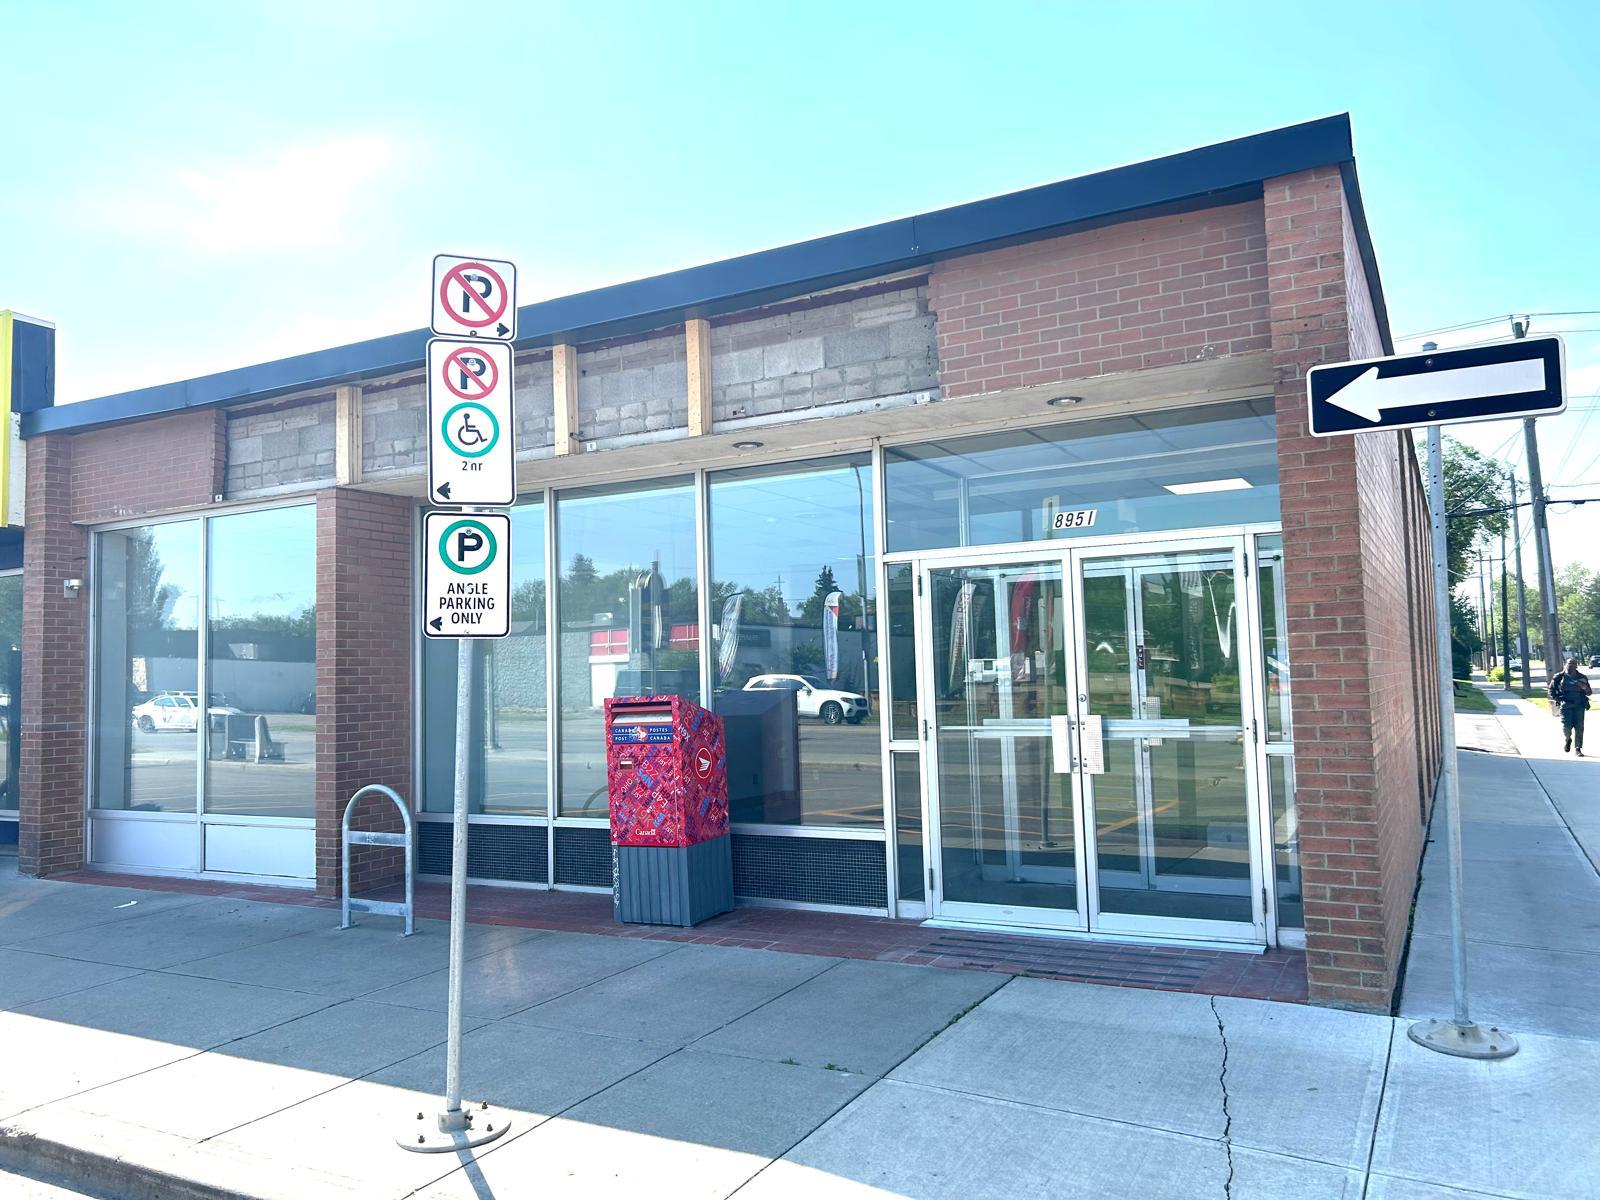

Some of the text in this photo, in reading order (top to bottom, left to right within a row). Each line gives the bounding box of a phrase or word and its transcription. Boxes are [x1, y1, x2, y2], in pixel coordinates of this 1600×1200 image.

[1055, 510, 1094, 529] 8951
[458, 532, 483, 562] P
[447, 582, 488, 595] ANGLE
[439, 597, 495, 610] PARKING
[451, 612, 483, 625] ONLY
[635, 828, 657, 837] Canada
